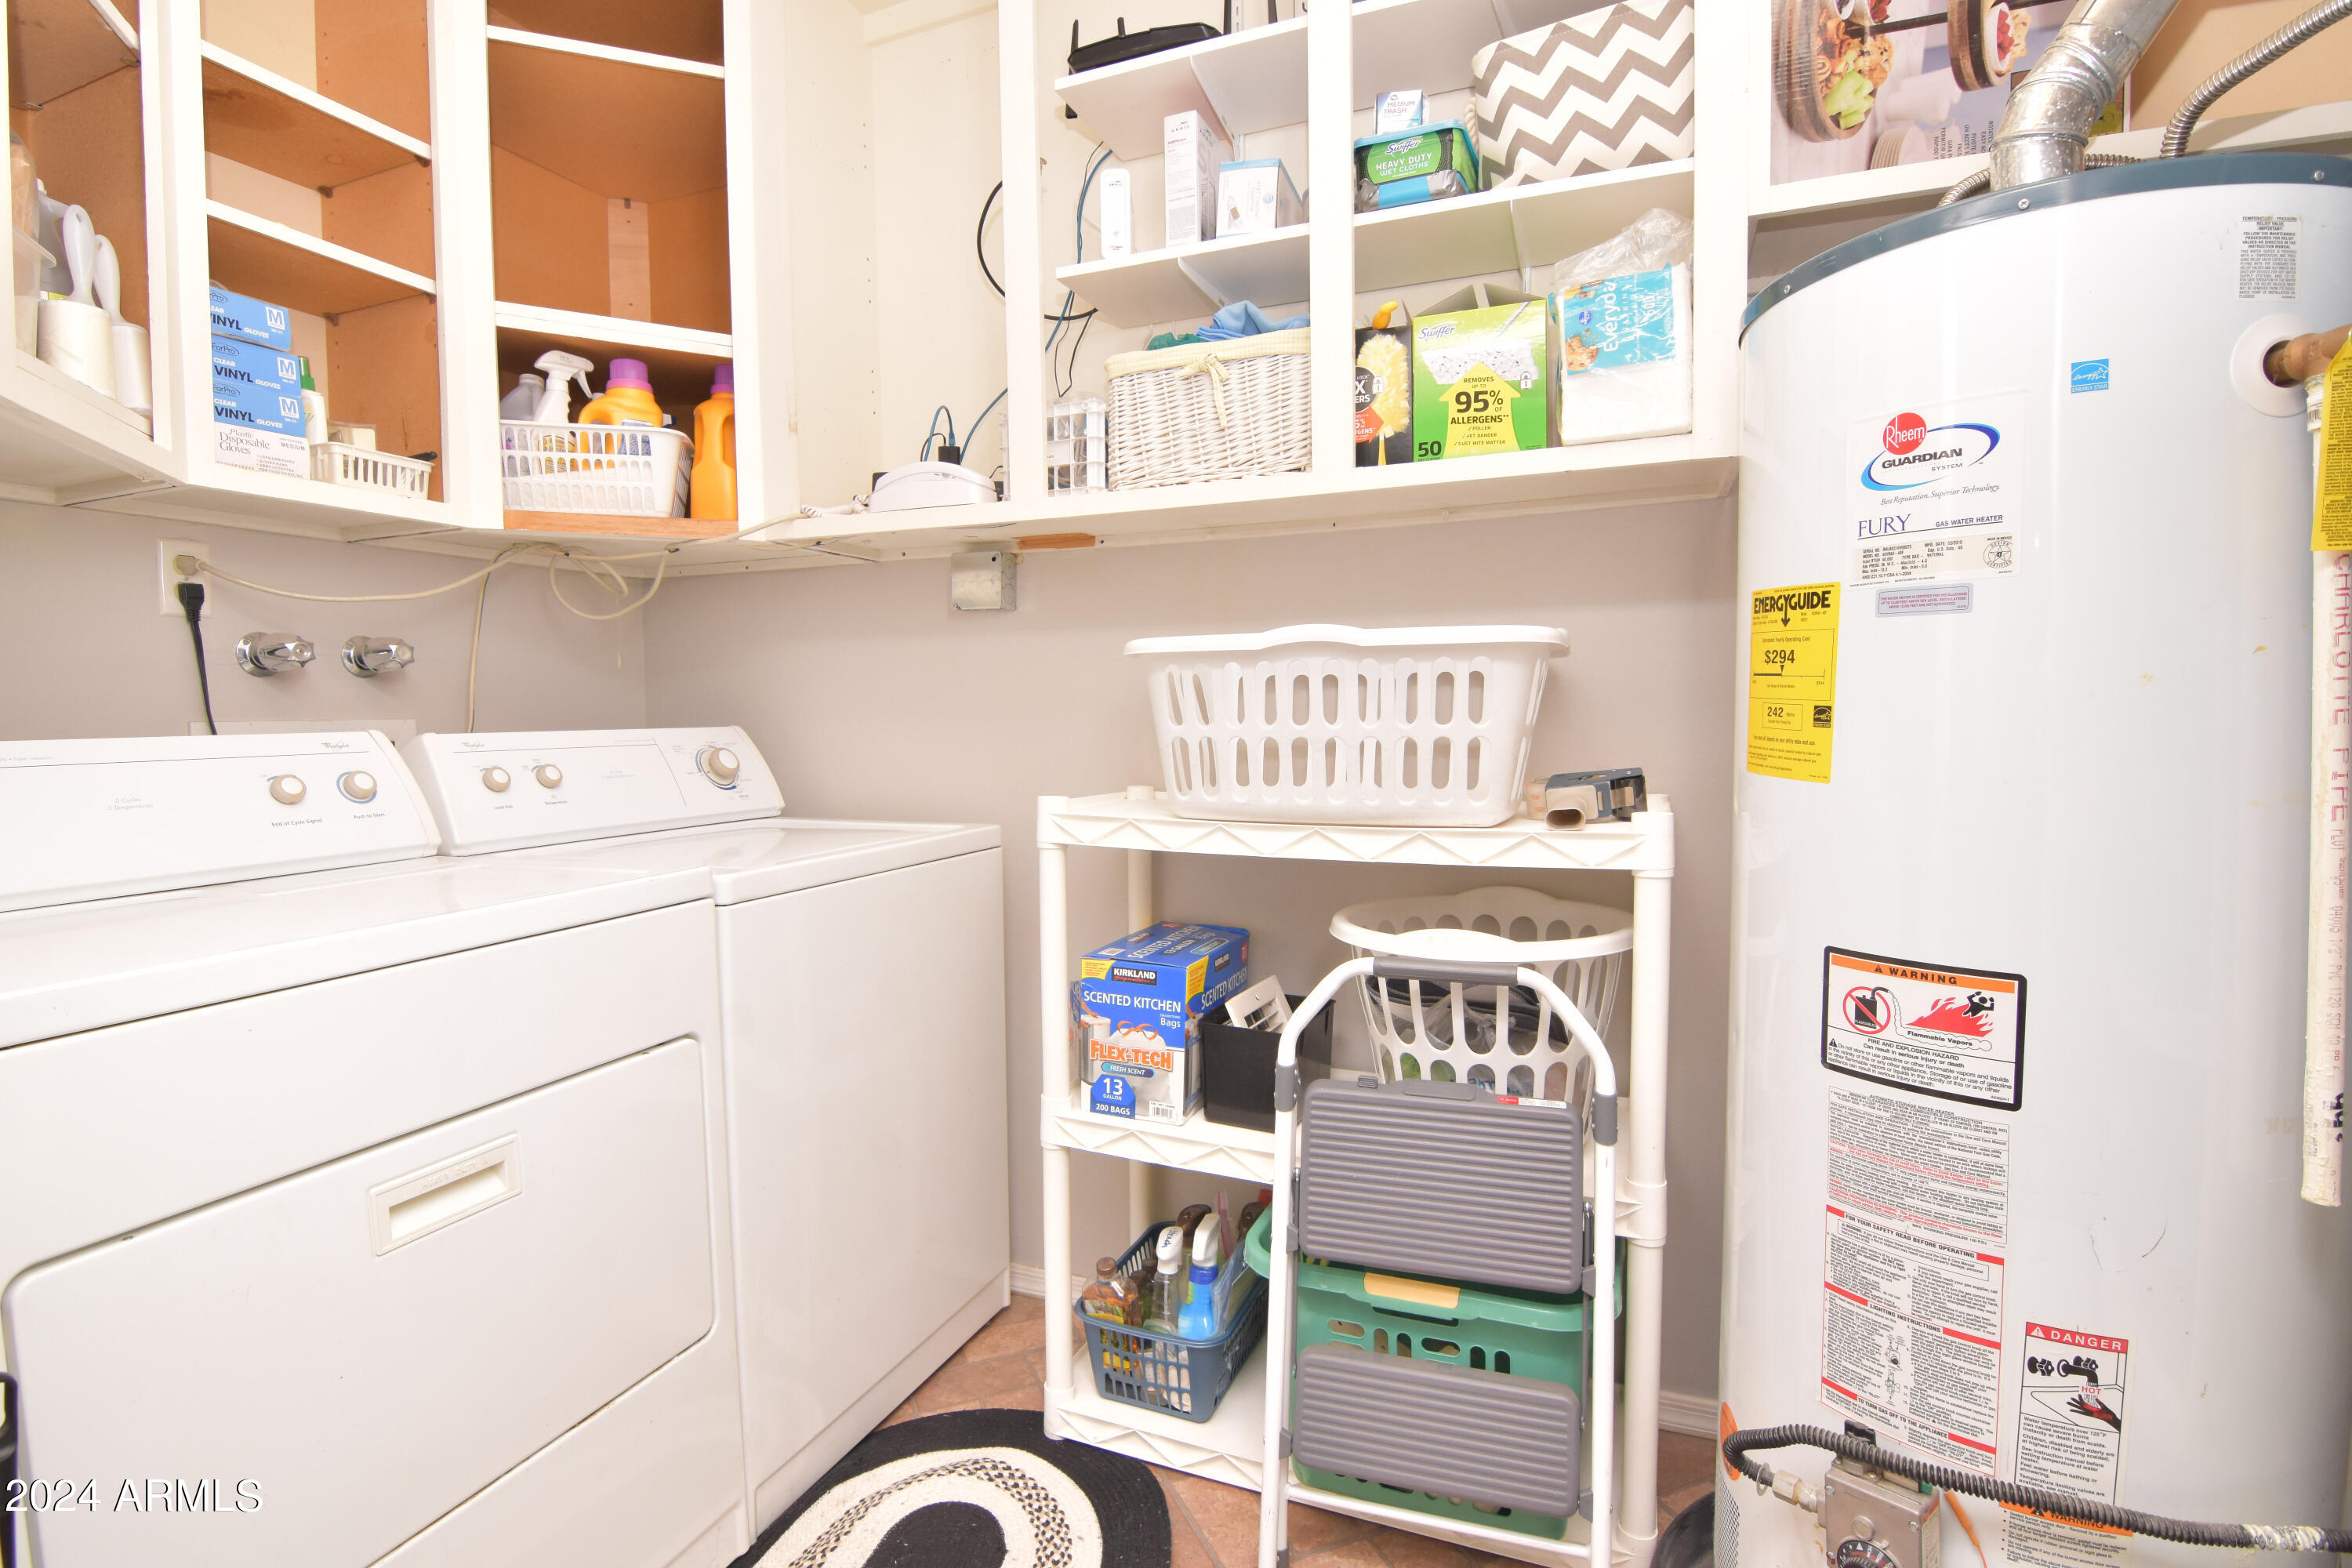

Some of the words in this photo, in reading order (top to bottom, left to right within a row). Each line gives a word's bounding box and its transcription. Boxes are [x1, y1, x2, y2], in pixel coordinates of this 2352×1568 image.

[1385, 140, 1419, 154] Swiffer
[1376, 158, 1405, 171] HEAVY
[1408, 152, 1432, 163] DUTY
[1380, 167, 1397, 176] WET
[1399, 162, 1429, 172] CLOTHS
[269, 309, 282, 325] M
[244, 327, 270, 339] GLOVES
[1417, 326, 1455, 342] Swiffer
[213, 358, 236, 367] CLEAR
[280, 360, 296, 376] M
[214, 365, 253, 383] VINYL
[256, 379, 281, 390] GLOVES
[214, 398, 237, 408] CLEAR
[282, 398, 296, 416] M
[1455, 390, 1504, 413] 95%
[214, 405, 254, 423] VINYL
[256, 419, 282, 429] GLOVES
[1886, 416, 1925, 448] Rheem
[220, 432, 270, 449] Disposable
[229, 428, 254, 439] Plastic
[220, 441, 251, 455] Gloves
[281, 442, 306, 451] MEDIUM
[1417, 441, 1442, 457] 50
[1882, 448, 1962, 469] GUARDIAN
[1932, 463, 1962, 471] SYSTEM
[1893, 494, 1929, 504] Reputation.
[1931, 488, 1960, 499] Superior
[1962, 484, 2000, 494] Technology.
[1858, 514, 1912, 538] FURY
[1754, 590, 1831, 614] ENERGYGUIDE
[2334, 554, 2350, 725] CHARLOTTE
[1764, 649, 1795, 665] $294
[1767, 706, 1784, 717] 242
[2332, 748, 2350, 822] PIPE
[1128, 941, 1171, 958] SCENTED
[1169, 925, 1203, 942] KITCHEN
[1215, 953, 1229, 967] KIRKLAND
[1113, 967, 1156, 979] KIRKLAND
[1889, 967, 1957, 985] WARNING
[1201, 985, 1226, 1010] SCENTED
[1228, 970, 1248, 993] KITCHEN
[1083, 991, 1131, 1007] SCENTED
[1134, 997, 1181, 1013] KITCHEN
[1160, 1018, 1181, 1029] Bags
[1907, 1031, 1945, 1042] Flammable
[1947, 1037, 1973, 1047] Vapors
[1091, 1040, 1171, 1069] FLEX-TECH
[1896, 1044, 1930, 1055] EXPLOSION
[1933, 1050, 1959, 1061] HAZARD
[1898, 1051, 1919, 1060] serious
[1921, 1055, 1937, 1064] injury
[1882, 1054, 1902, 1064] gasoline
[1926, 1063, 1955, 1074] flammable
[1104, 1078, 1123, 1095] 13
[1110, 1105, 1131, 1115] BAGS
[1846, 1214, 1855, 1223] FOR
[1857, 1218, 1871, 1228] YOUR
[1873, 1223, 1894, 1236] SAFETY
[1896, 1232, 1911, 1241] READ
[1913, 1237, 1936, 1249] BEFORE
[1938, 1243, 1975, 1258] OPERATING
[1870, 1303, 1896, 1318] LIGHTING
[1897, 1314, 1941, 1333] INSTRUCTIONS
[2051, 1330, 2122, 1350] DANGER
[2082, 1386, 2101, 1395] HOT
[1865, 1400, 1878, 1410] TURN
[1878, 1407, 1888, 1416] GAS
[1889, 1410, 1899, 1419] OFF
[1907, 1418, 1917, 1428] THE
[1918, 1424, 1947, 1439] APPLIANCE
[2042, 1421, 2074, 1432] temperature
